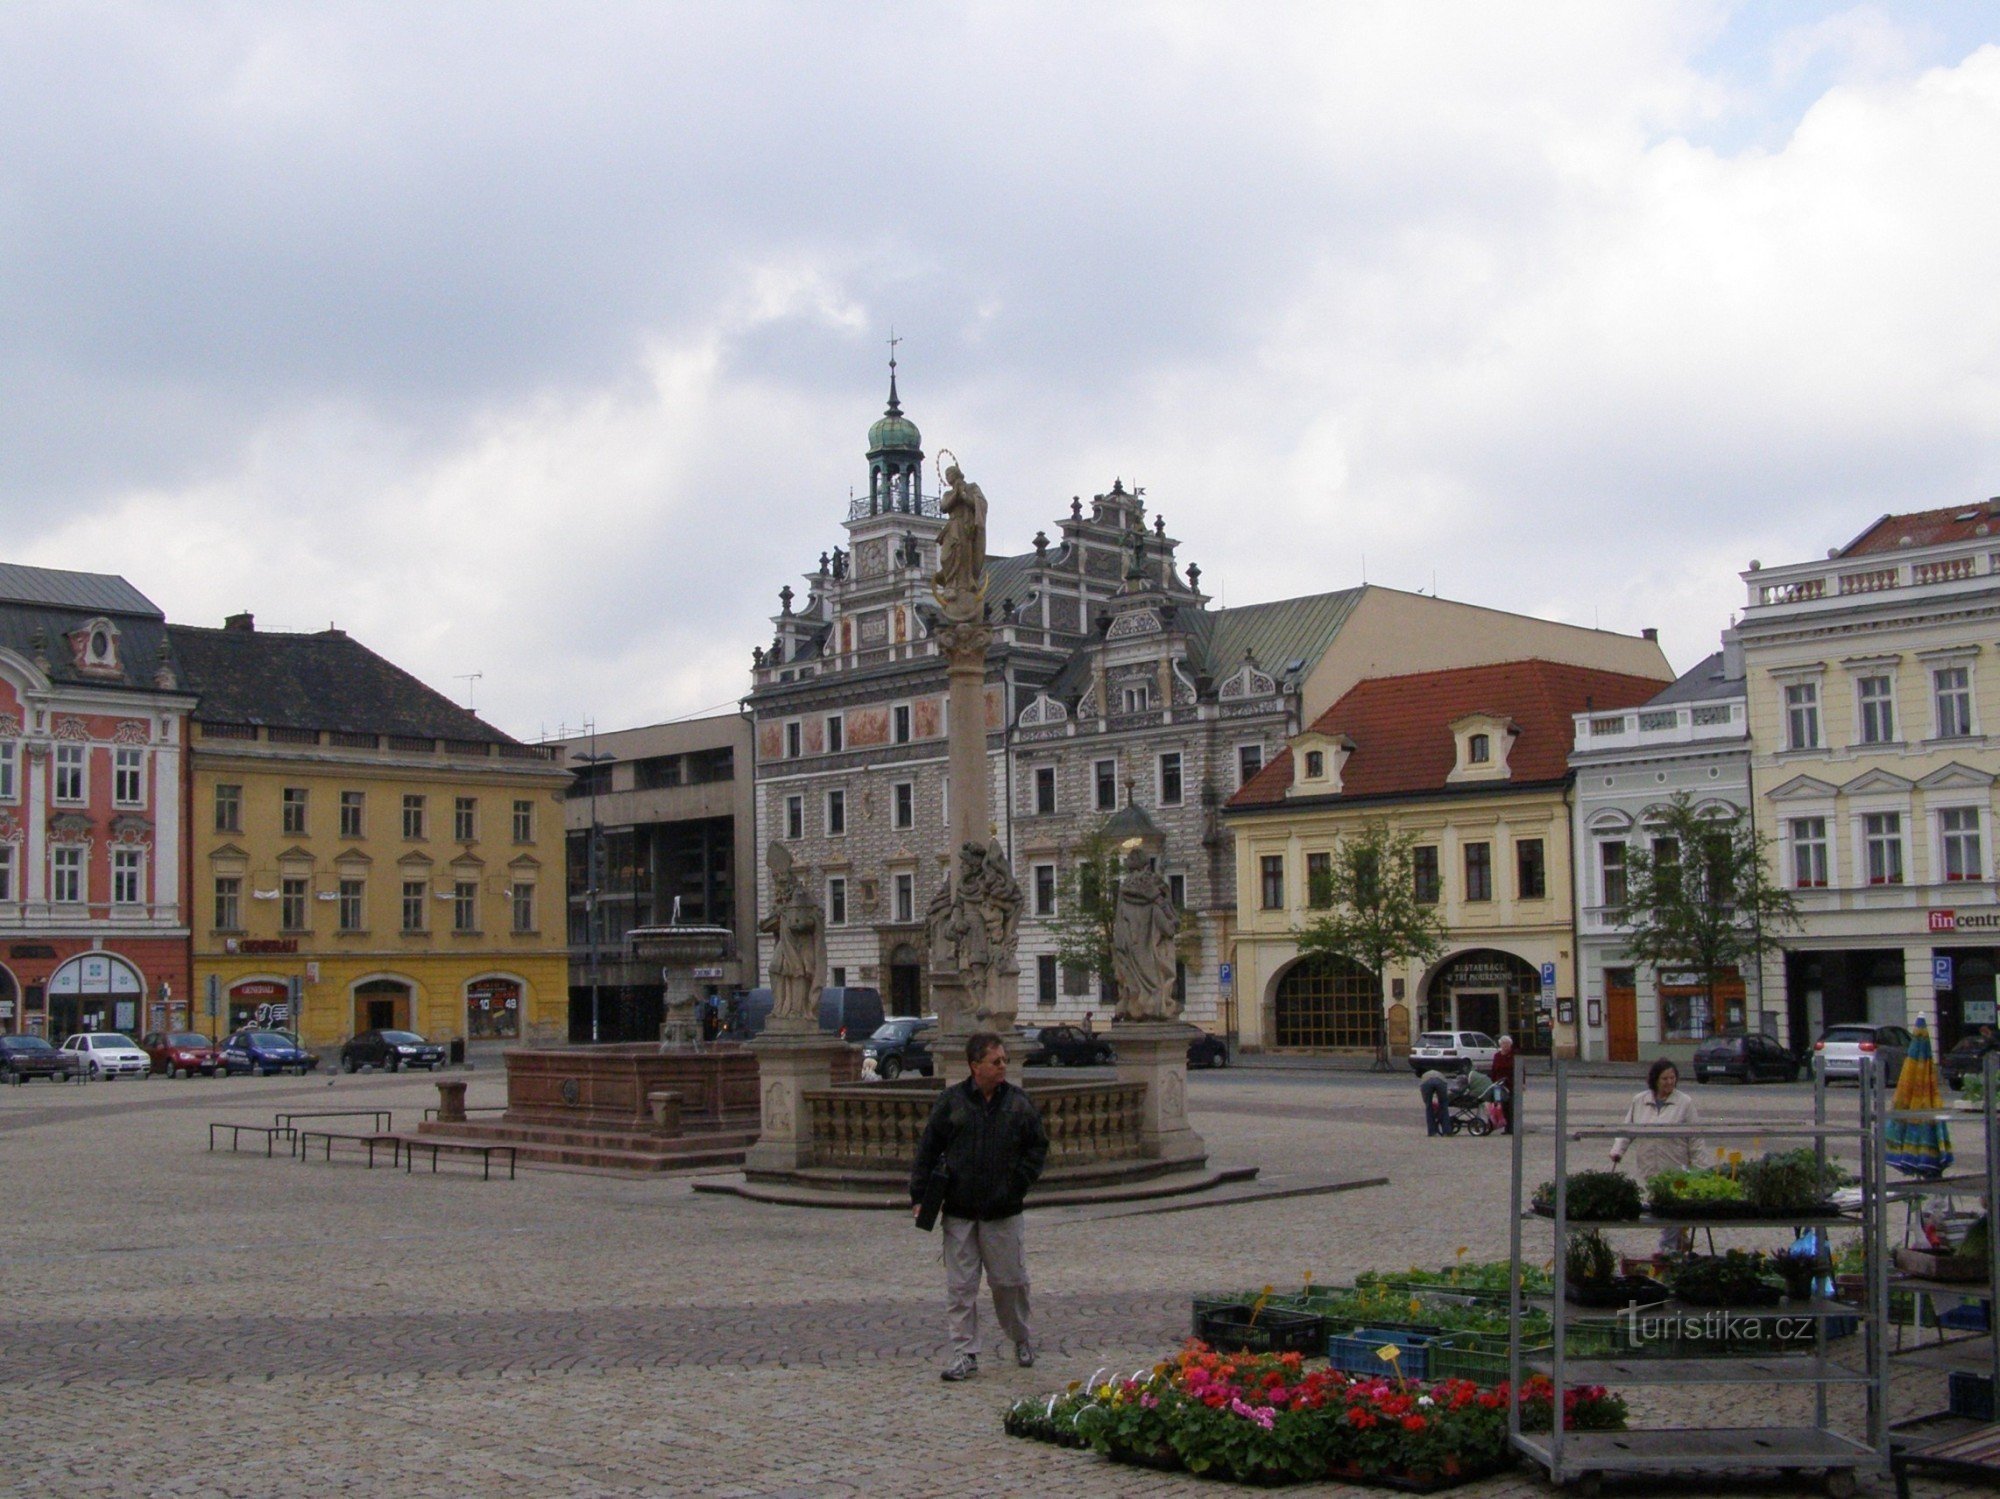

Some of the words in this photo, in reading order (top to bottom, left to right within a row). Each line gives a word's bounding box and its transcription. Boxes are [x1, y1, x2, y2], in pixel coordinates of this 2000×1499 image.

[1222, 965, 1230, 978] P
[1544, 964, 1553, 978] P
[1936, 960, 1947, 975] P
